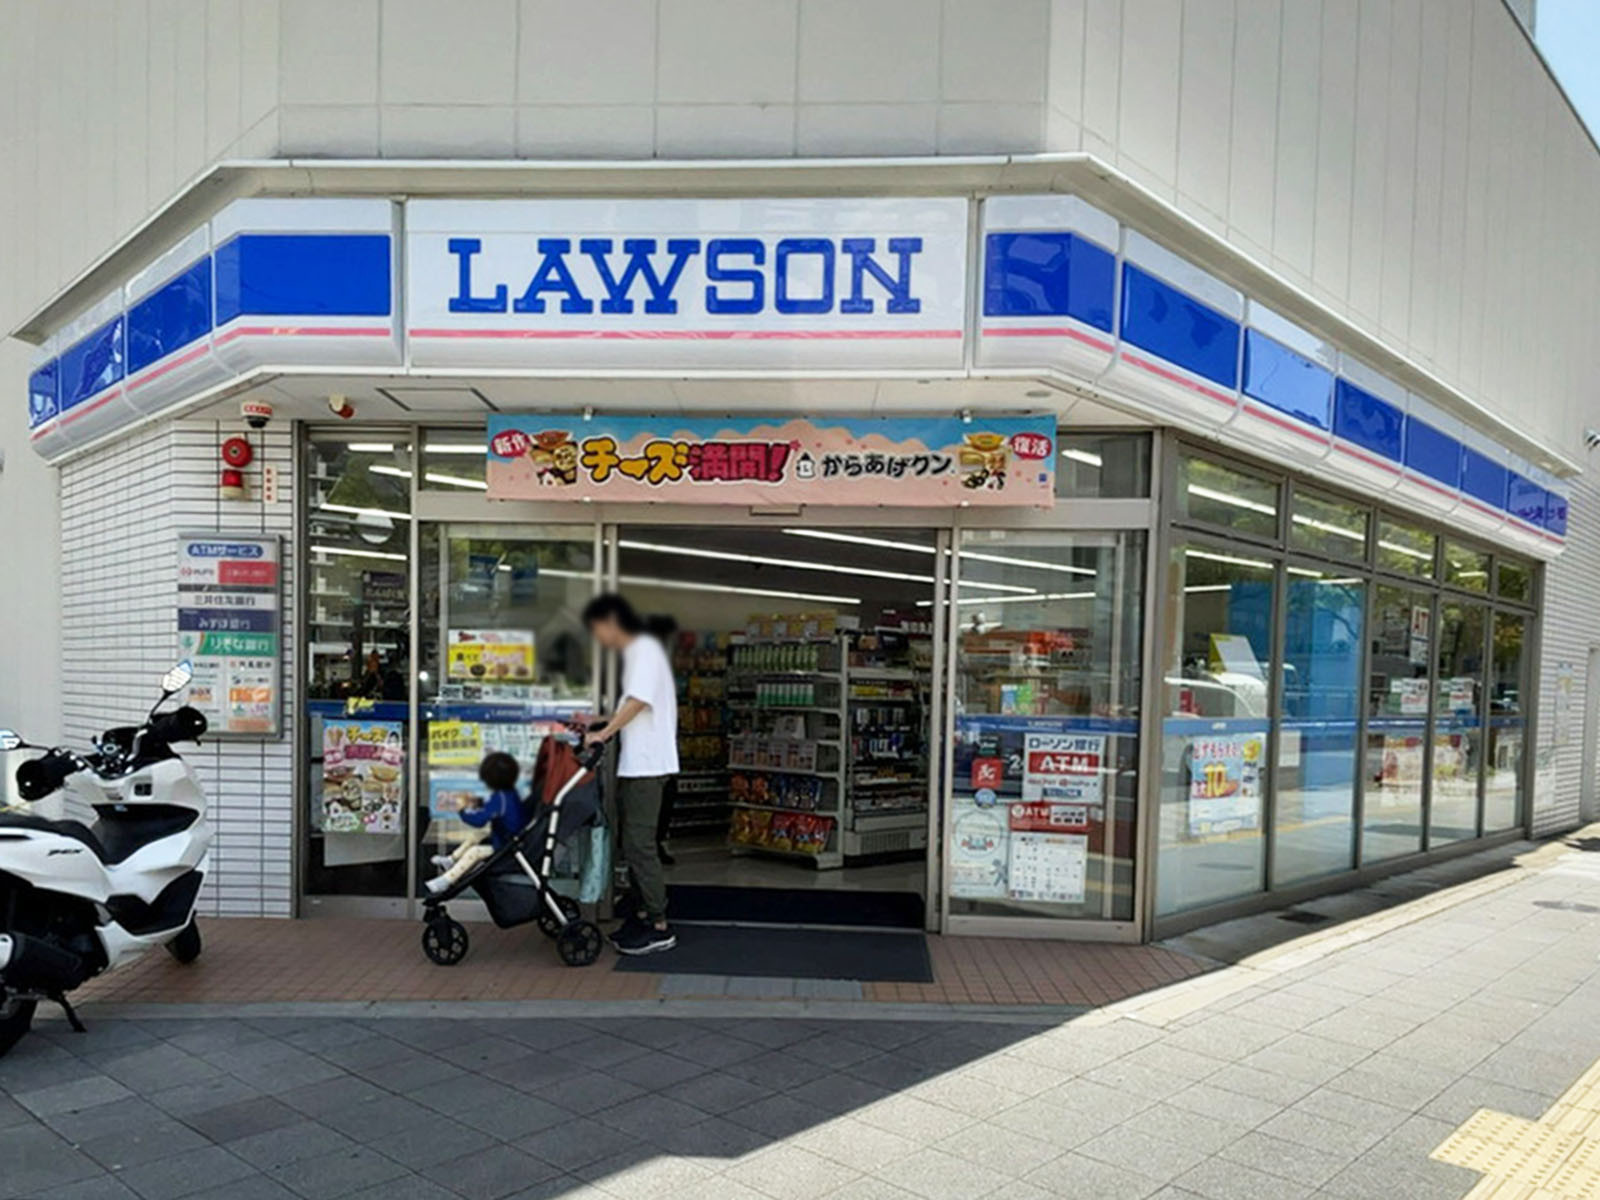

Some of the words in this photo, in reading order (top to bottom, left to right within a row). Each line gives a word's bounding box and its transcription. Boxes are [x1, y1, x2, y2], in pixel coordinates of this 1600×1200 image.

[448, 237, 923, 314] LAWSON
[494, 436, 528, 455] 新作
[1013, 437, 1050, 457] 復活
[822, 454, 953, 477] からあげクン
[191, 544, 260, 557] ATMサービス
[198, 617, 251, 629] みずほ銀行
[210, 638, 270, 651] りそな銀行
[1029, 737, 1101, 751] ローソン銀行
[1039, 755, 1089, 772] ATM
